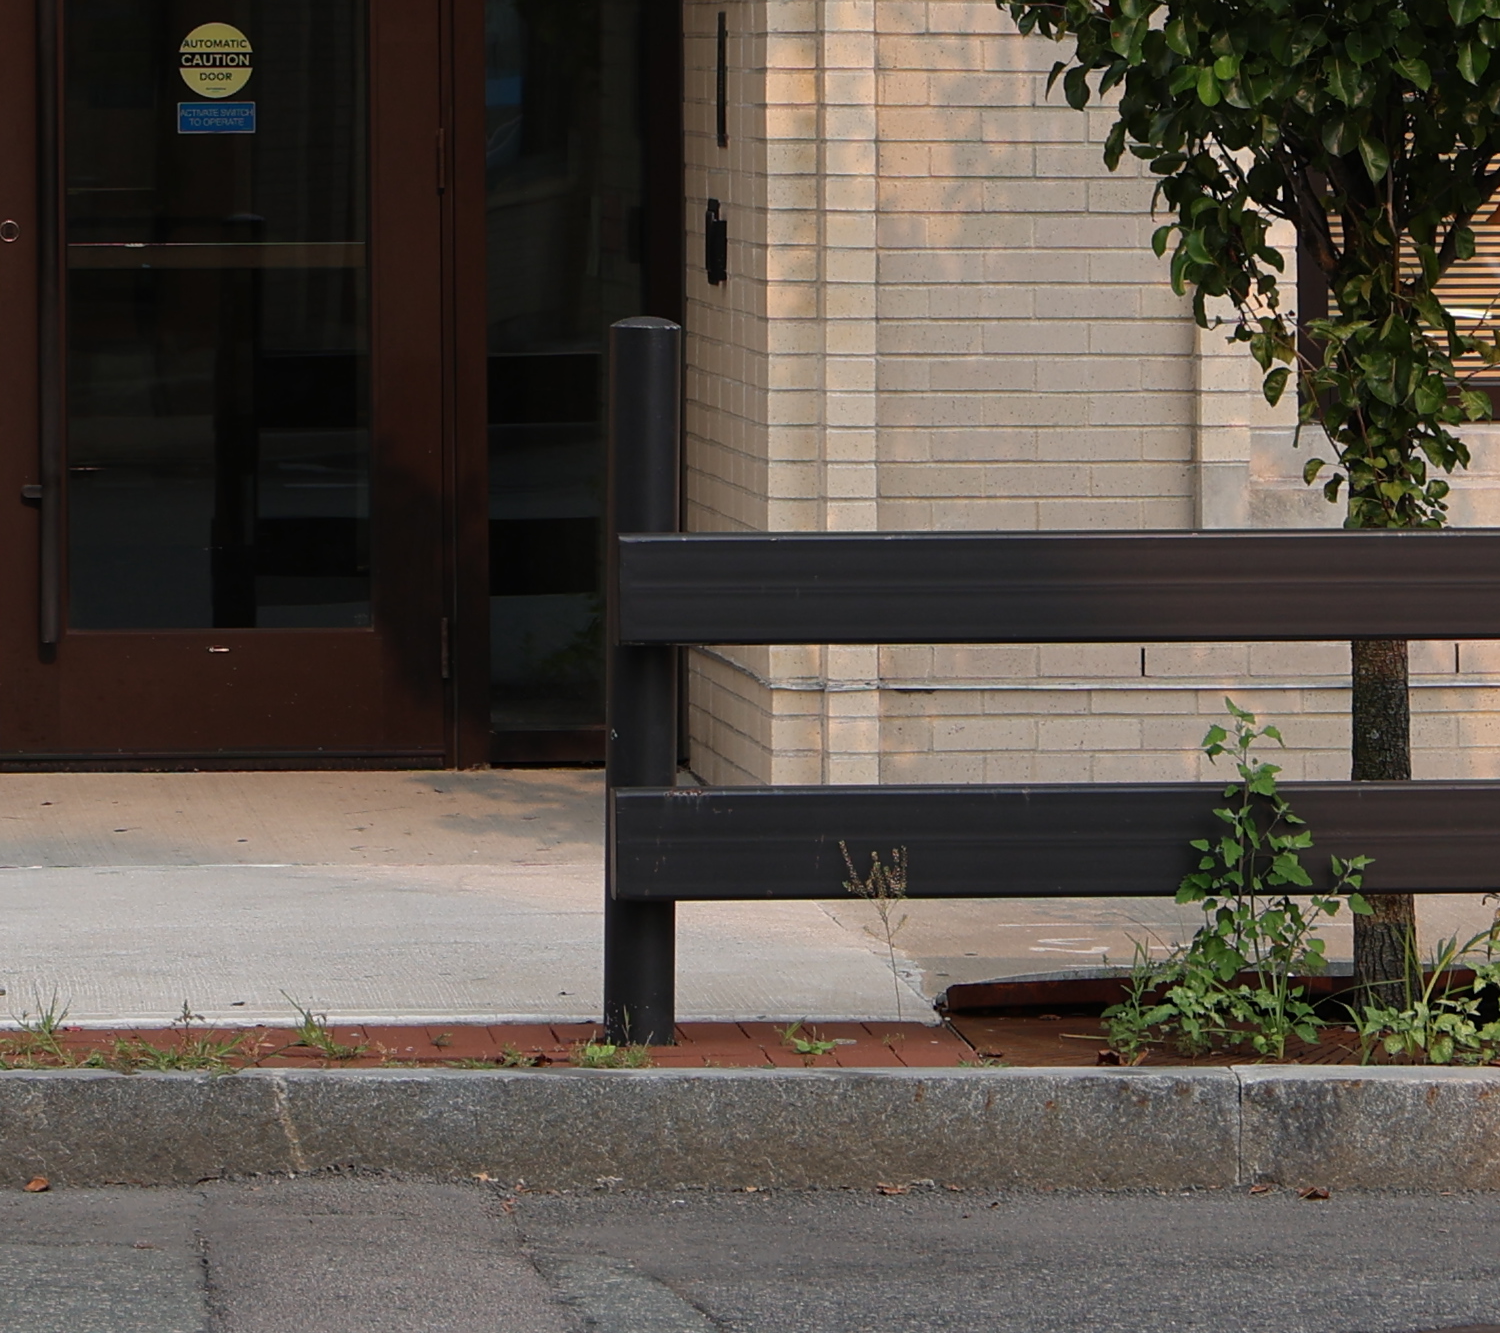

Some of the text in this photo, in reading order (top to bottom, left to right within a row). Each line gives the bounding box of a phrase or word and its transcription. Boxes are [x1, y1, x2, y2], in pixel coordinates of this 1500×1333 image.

[182, 39, 248, 49] AUTOMATIC
[181, 54, 250, 66] CAUTION
[199, 72, 233, 81] DOOR
[180, 108, 254, 117] ACTIVATE SWITCH
[189, 118, 245, 126] TO OPERATE
